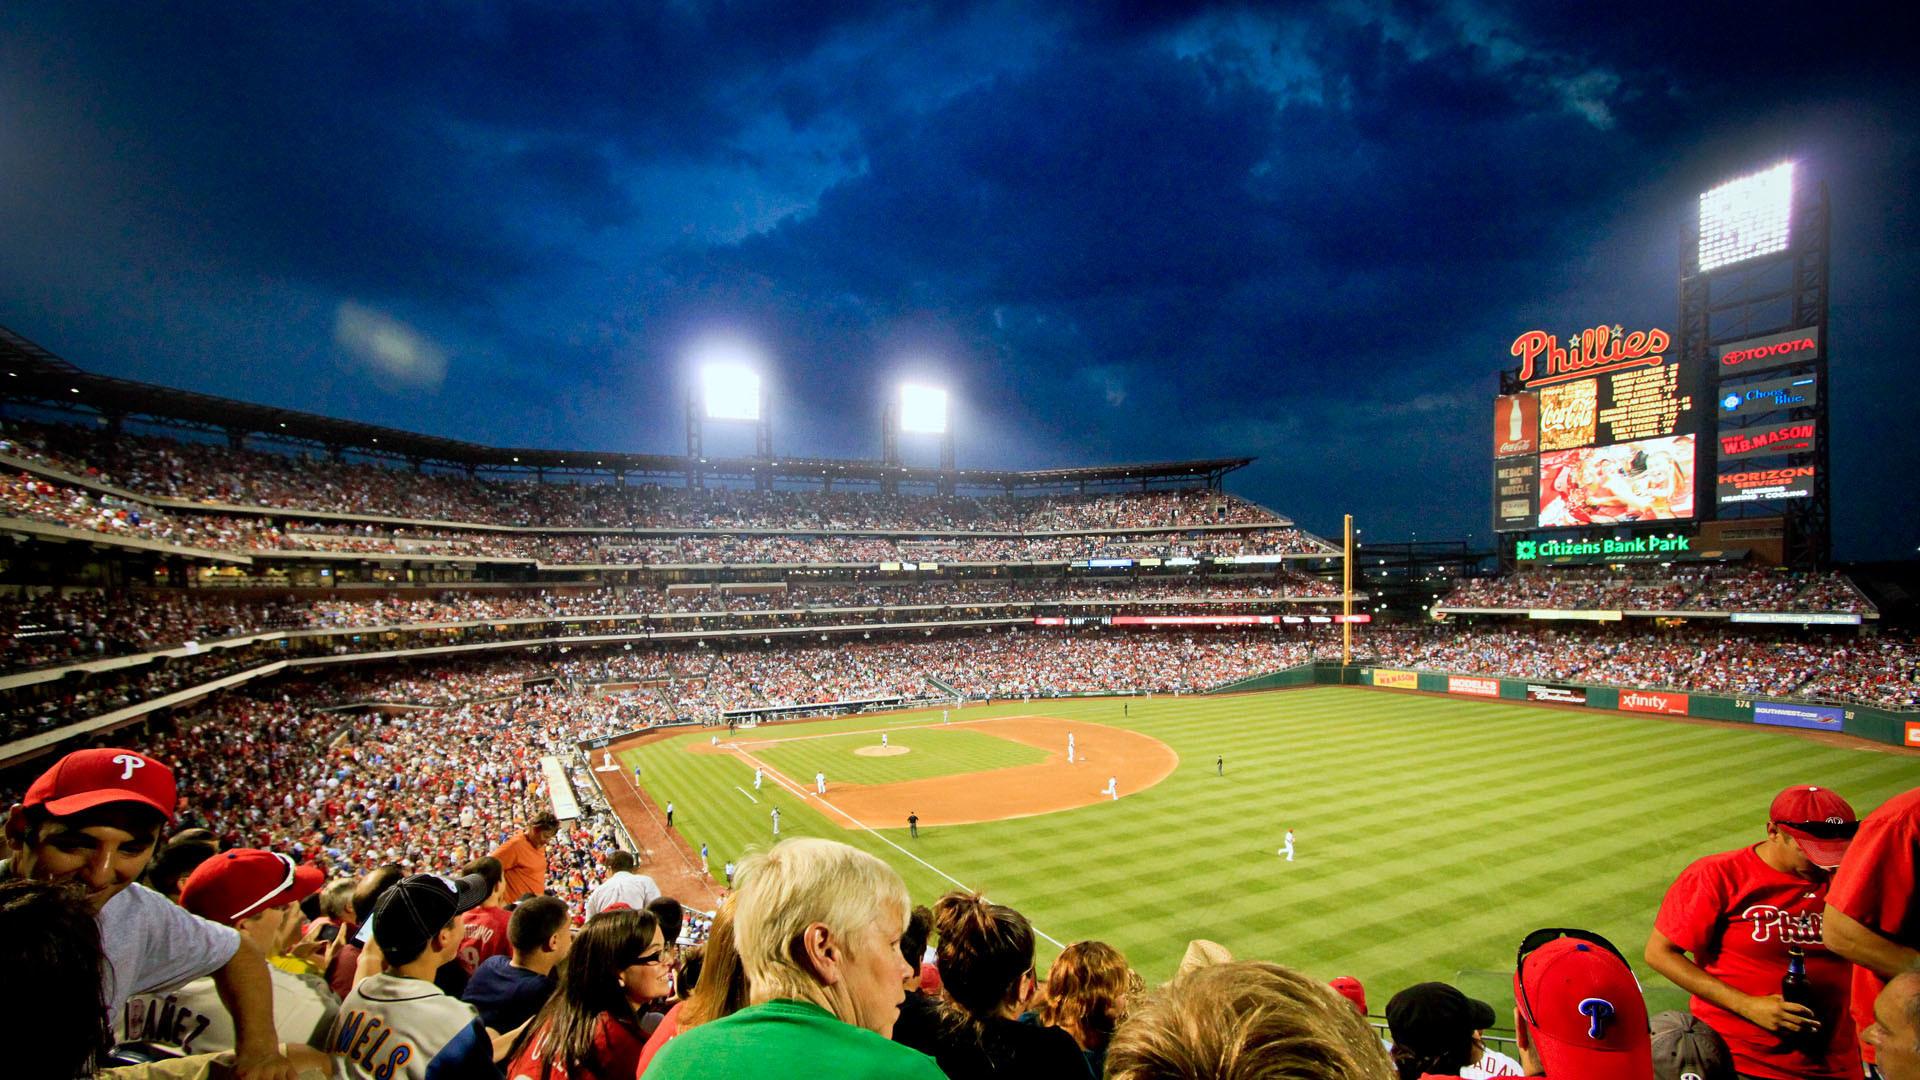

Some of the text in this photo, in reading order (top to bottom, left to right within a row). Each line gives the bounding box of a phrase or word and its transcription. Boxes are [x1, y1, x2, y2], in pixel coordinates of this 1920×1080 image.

[1511, 325, 1670, 380] Phillies
[1745, 338, 1814, 360] TOYOTA
[1663, 384, 1678, 392] 777
[1746, 389, 1790, 400] Choos
[1664, 412, 1678, 420] 777
[1662, 419, 1677, 427] 777
[1500, 440, 1531, 453] Coca-Cola
[1498, 466, 1534, 479] MEDICINE
[1718, 466, 1814, 484] HORIZON
[1501, 483, 1530, 496] MUSCLE
[1735, 478, 1792, 488] SERVICES
[1765, 490, 1808, 499] COOLING
[1539, 535, 1689, 556] Citizens Bank Park
[1623, 693, 1668, 710] xfinity
[112, 754, 146, 780] P
[1578, 998, 1615, 1039] P
